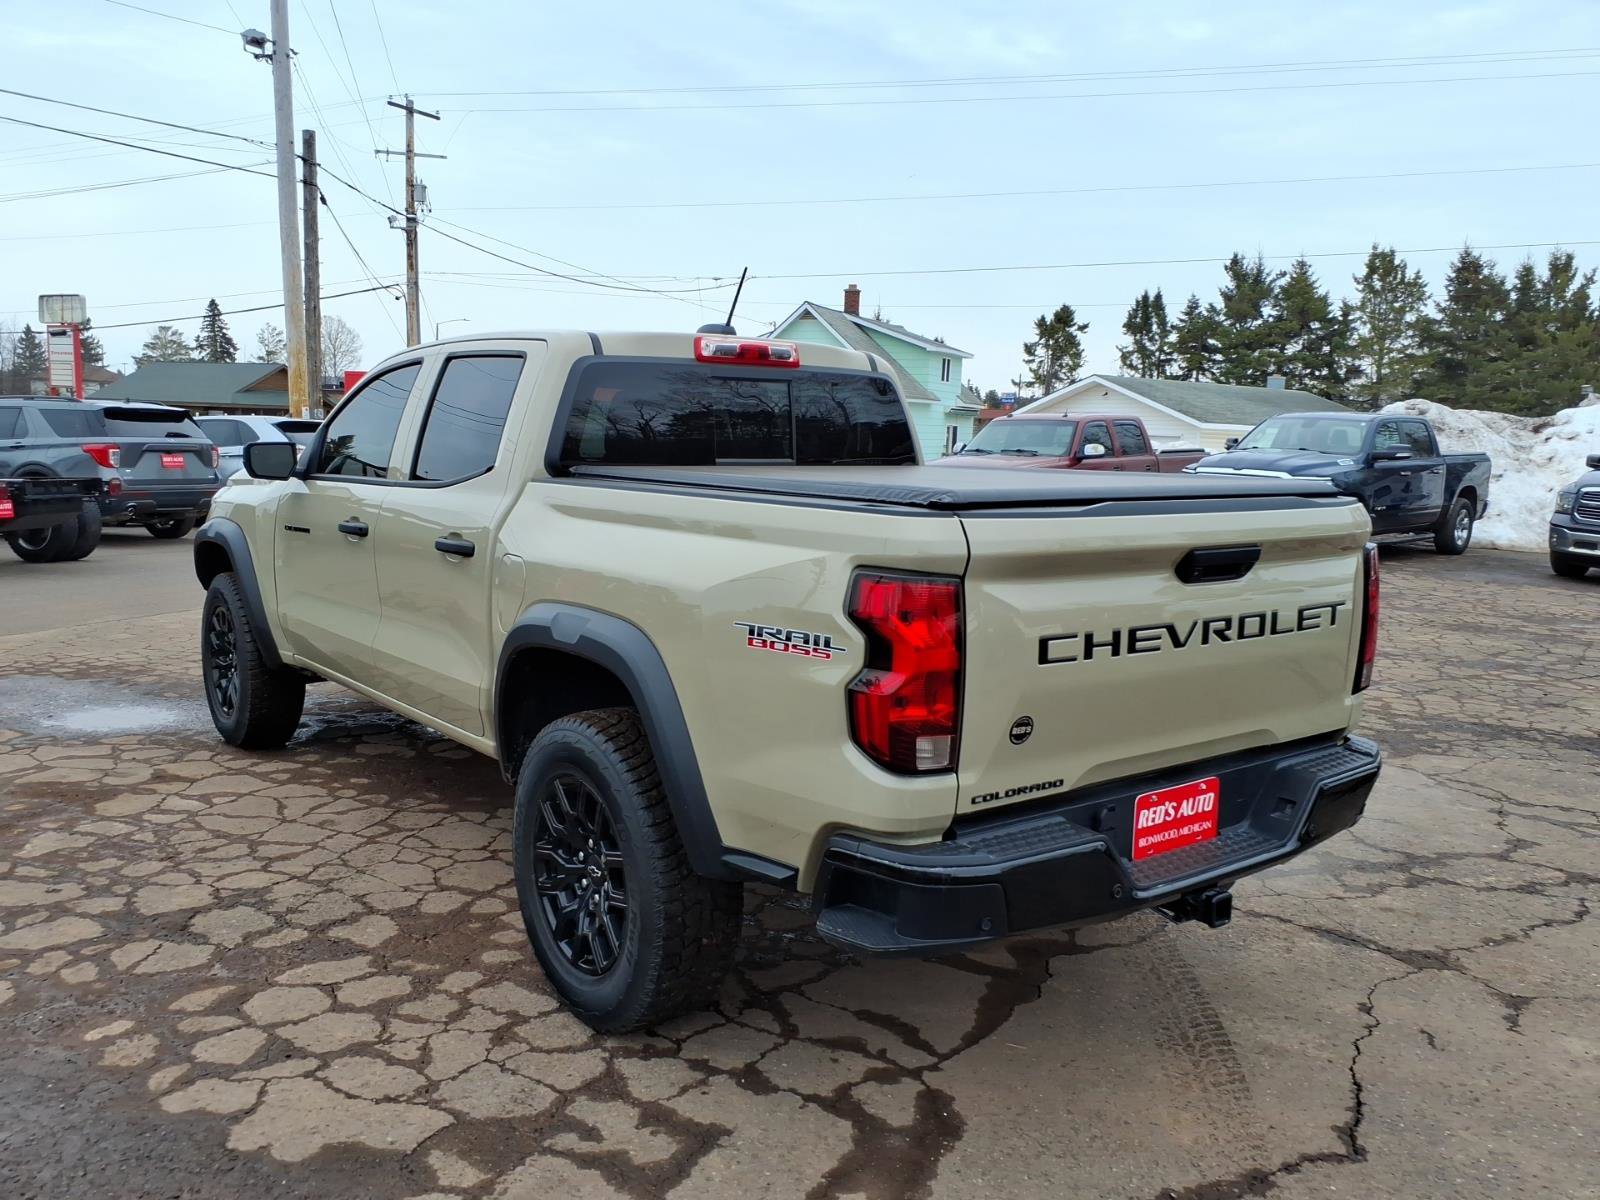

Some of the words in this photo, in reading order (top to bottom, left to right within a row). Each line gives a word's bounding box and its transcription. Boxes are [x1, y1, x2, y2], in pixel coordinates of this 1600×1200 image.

[733, 622, 846, 652] TRAIL
[1038, 601, 1346, 666] CHEVROLET
[747, 637, 832, 660] BOSS
[971, 778, 1064, 805] COLORADO
[1137, 800, 1178, 829] RED'S
[1177, 792, 1215, 819] AUTO
[1138, 828, 1179, 848] IRONWOOD,
[1179, 820, 1213, 837] MICHIGAN
